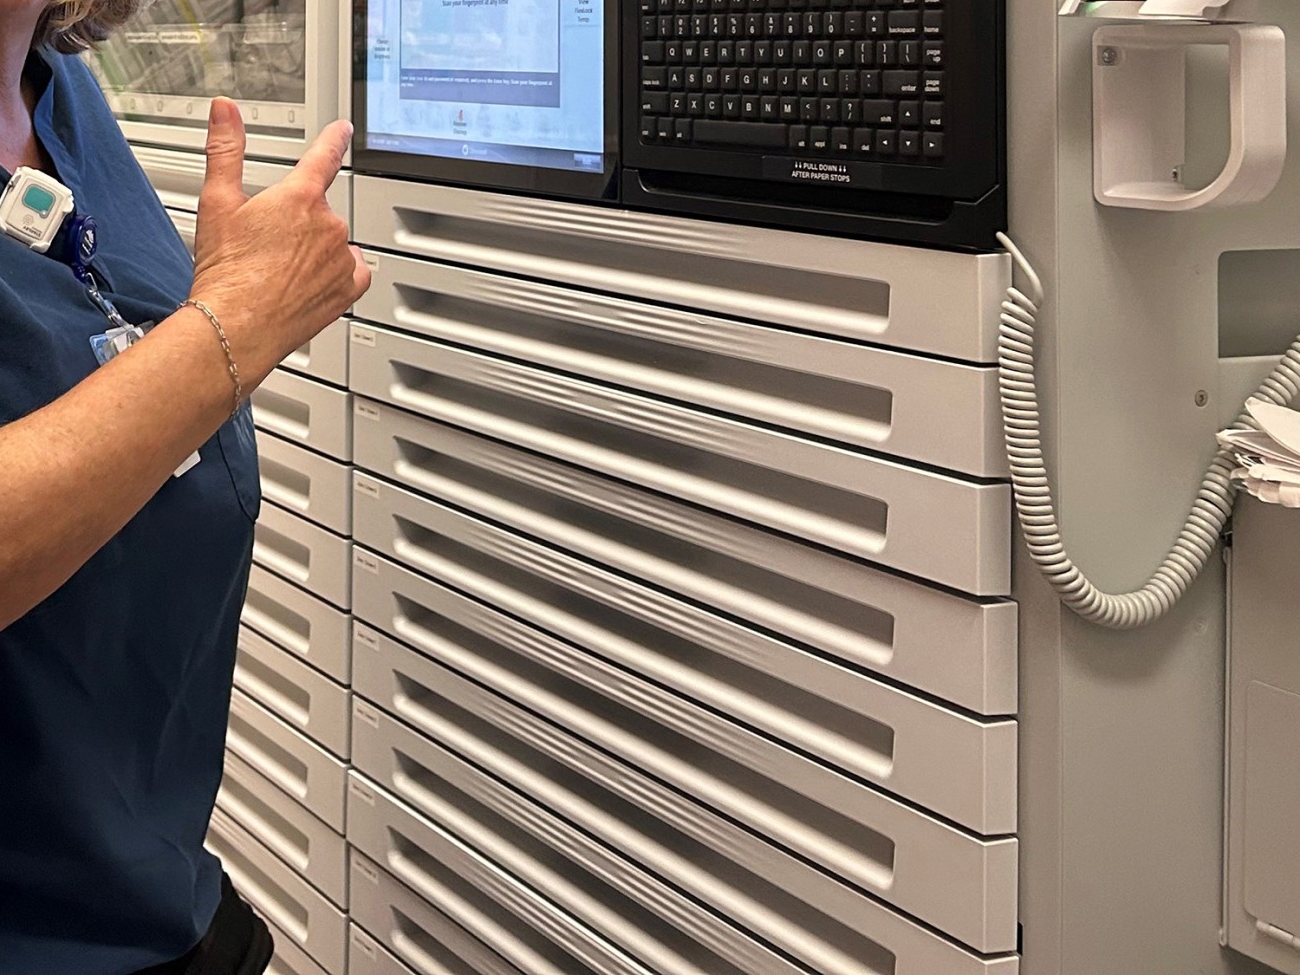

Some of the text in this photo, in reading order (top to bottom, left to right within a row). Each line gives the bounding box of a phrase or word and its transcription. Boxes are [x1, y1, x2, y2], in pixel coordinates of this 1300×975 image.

[441, 0, 452, 7] Scan
[452, 0, 461, 8] your
[489, 0, 498, 8] any
[669, 48, 675, 56] Q
[685, 48, 693, 56] W
[703, 48, 709, 56] E
[721, 48, 728, 56] R
[740, 48, 746, 56] T
[758, 48, 765, 56] Y
[817, 48, 824, 57] O
[838, 49, 844, 57] P
[671, 74, 678, 82] A
[706, 75, 713, 83] D
[725, 75, 730, 83] F
[743, 75, 750, 84] G
[762, 76, 769, 84] H
[783, 76, 788, 84] J
[801, 77, 808, 85] K
[822, 77, 828, 86] L
[674, 100, 679, 108] Z
[709, 101, 715, 109] C
[727, 102, 733, 110] V
[746, 103, 752, 111] B
[765, 104, 771, 112] N
[784, 104, 791, 112] M
[803, 162, 838, 172] PULL DOWN
[791, 171, 810, 179] AFTER
[830, 174, 850, 182] STOPS
